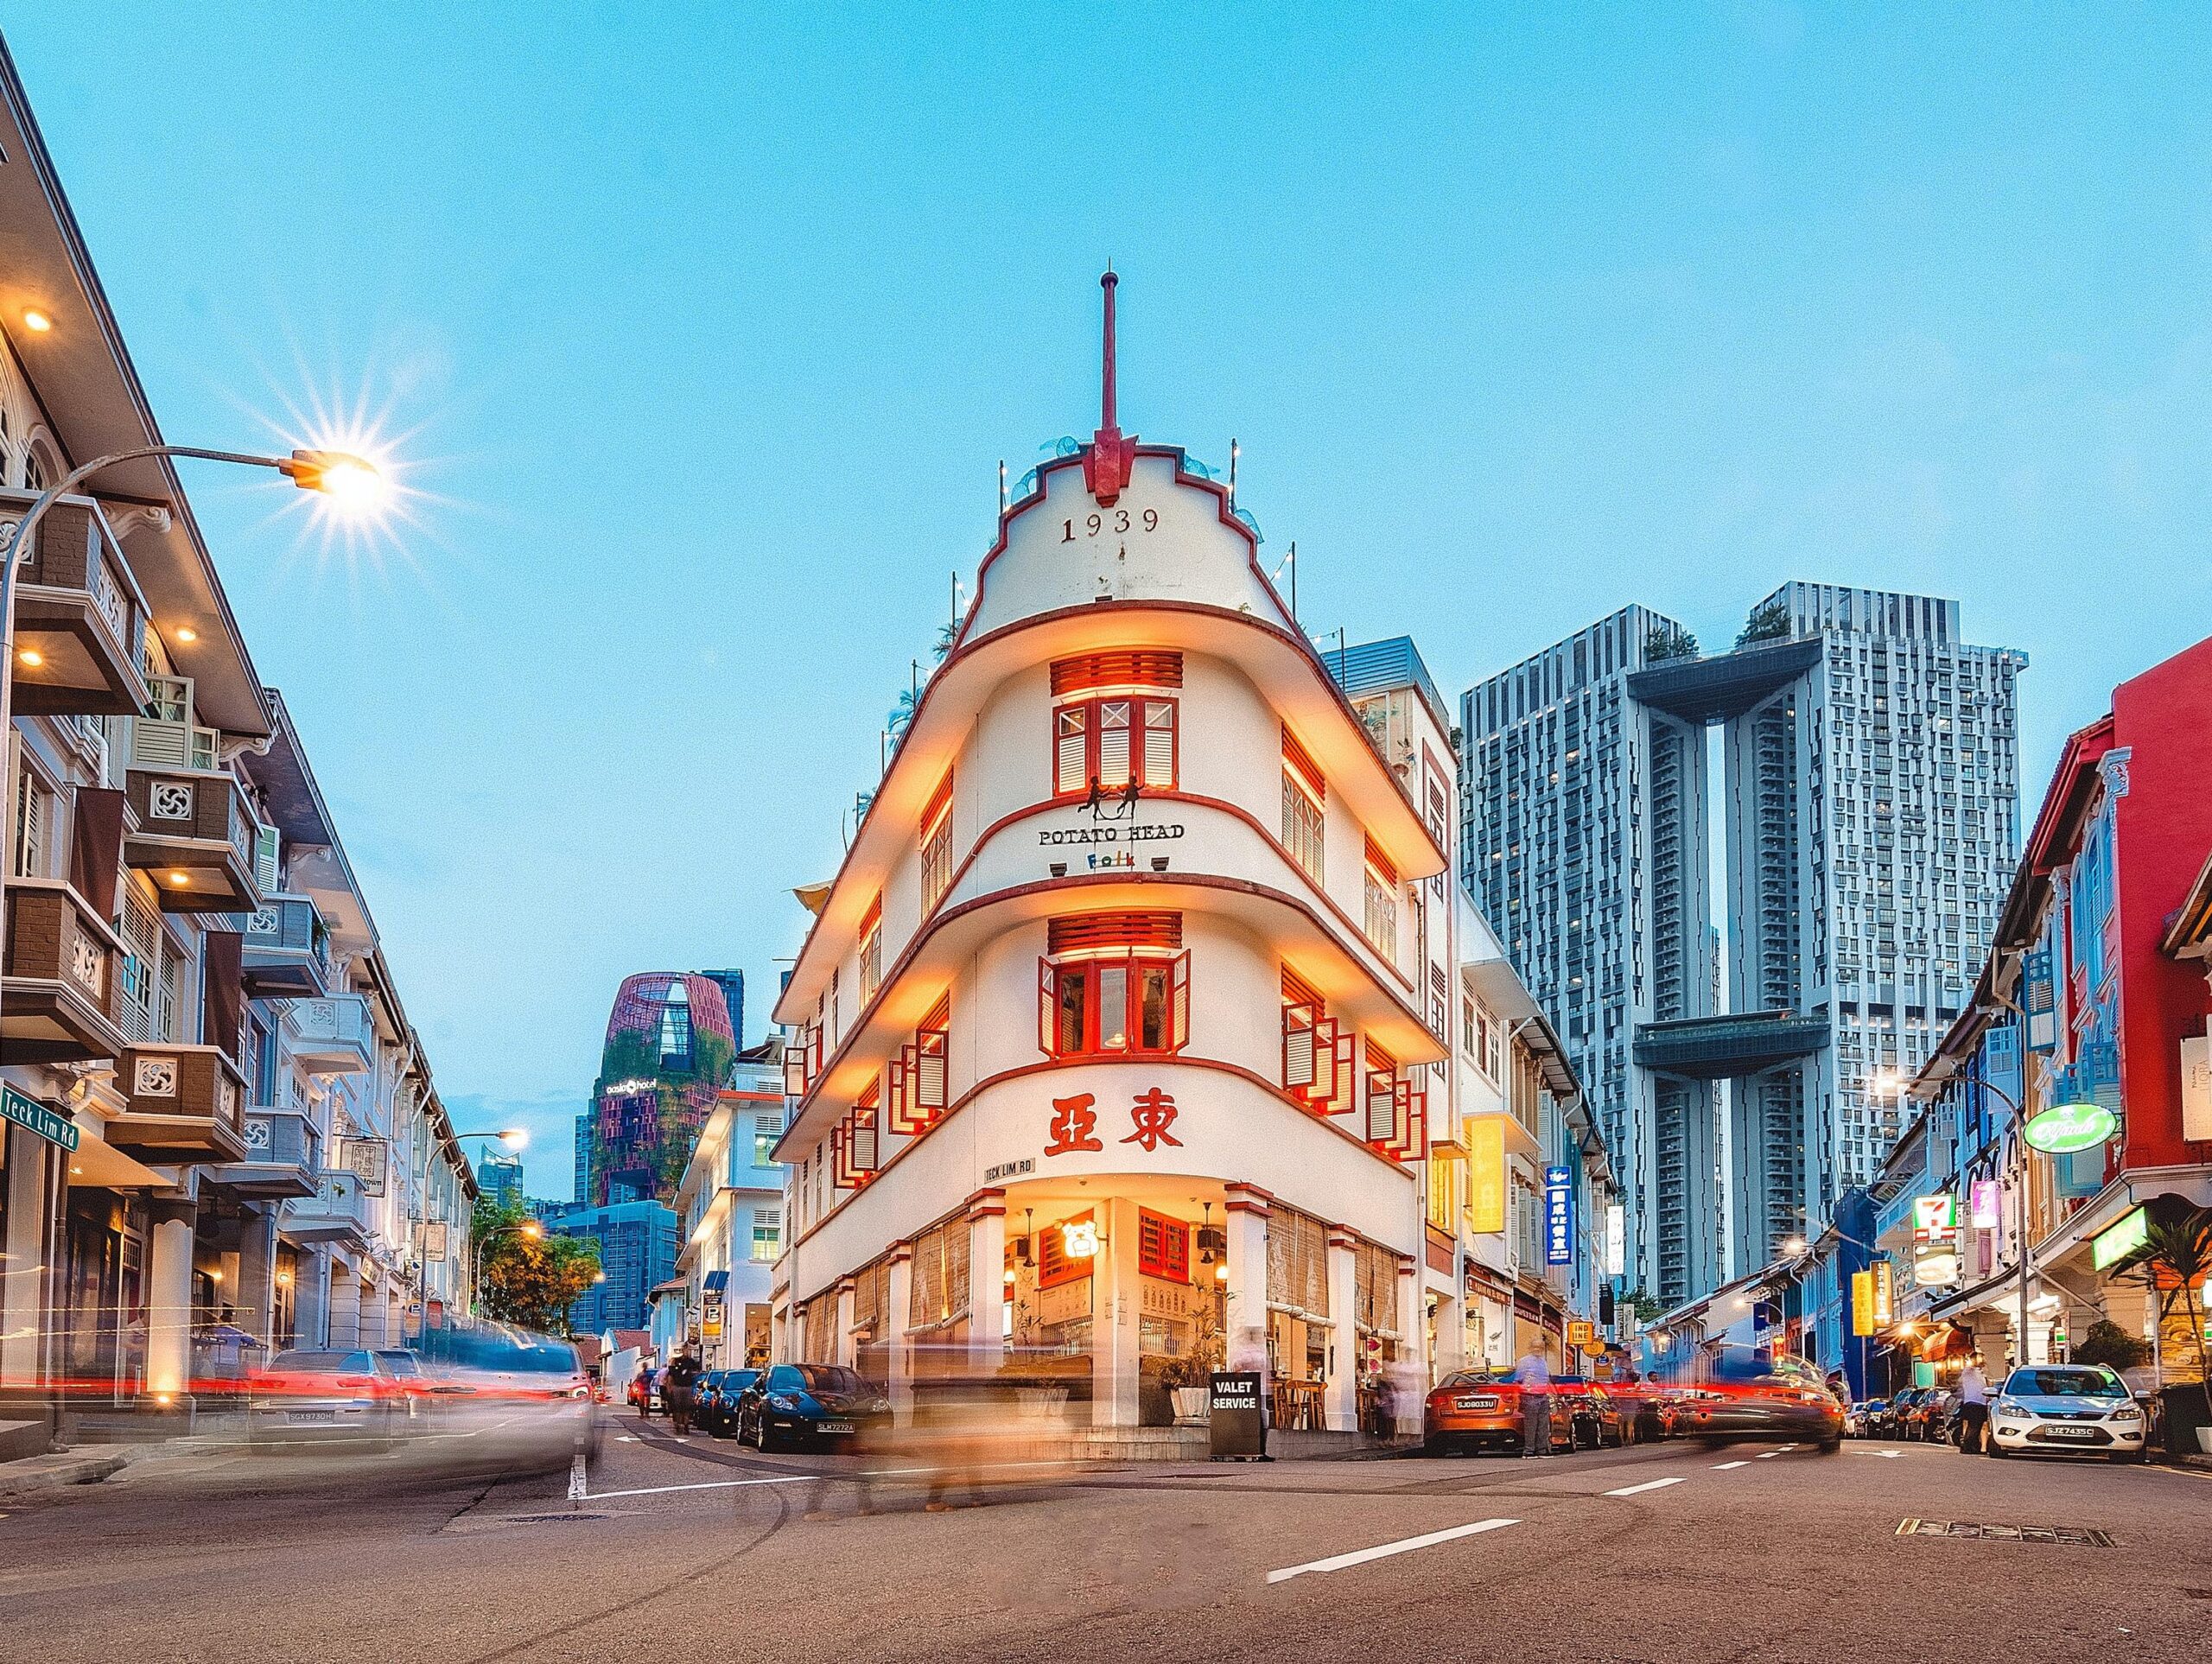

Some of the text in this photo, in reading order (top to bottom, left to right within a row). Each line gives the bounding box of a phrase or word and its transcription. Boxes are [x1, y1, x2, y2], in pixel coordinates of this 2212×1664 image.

[1060, 508, 1160, 543] 1939
[1039, 824, 1185, 846] POTATO HEAD
[1087, 850, 1135, 870] Folk
[637, 1078, 657, 1089] hotel
[6, 1092, 75, 1147] Teck Lim Rd
[986, 1159, 1031, 1181] TECK LIM RD
[1216, 1381, 1253, 1393] VALET
[1213, 1398, 1256, 1409] SERVICE
